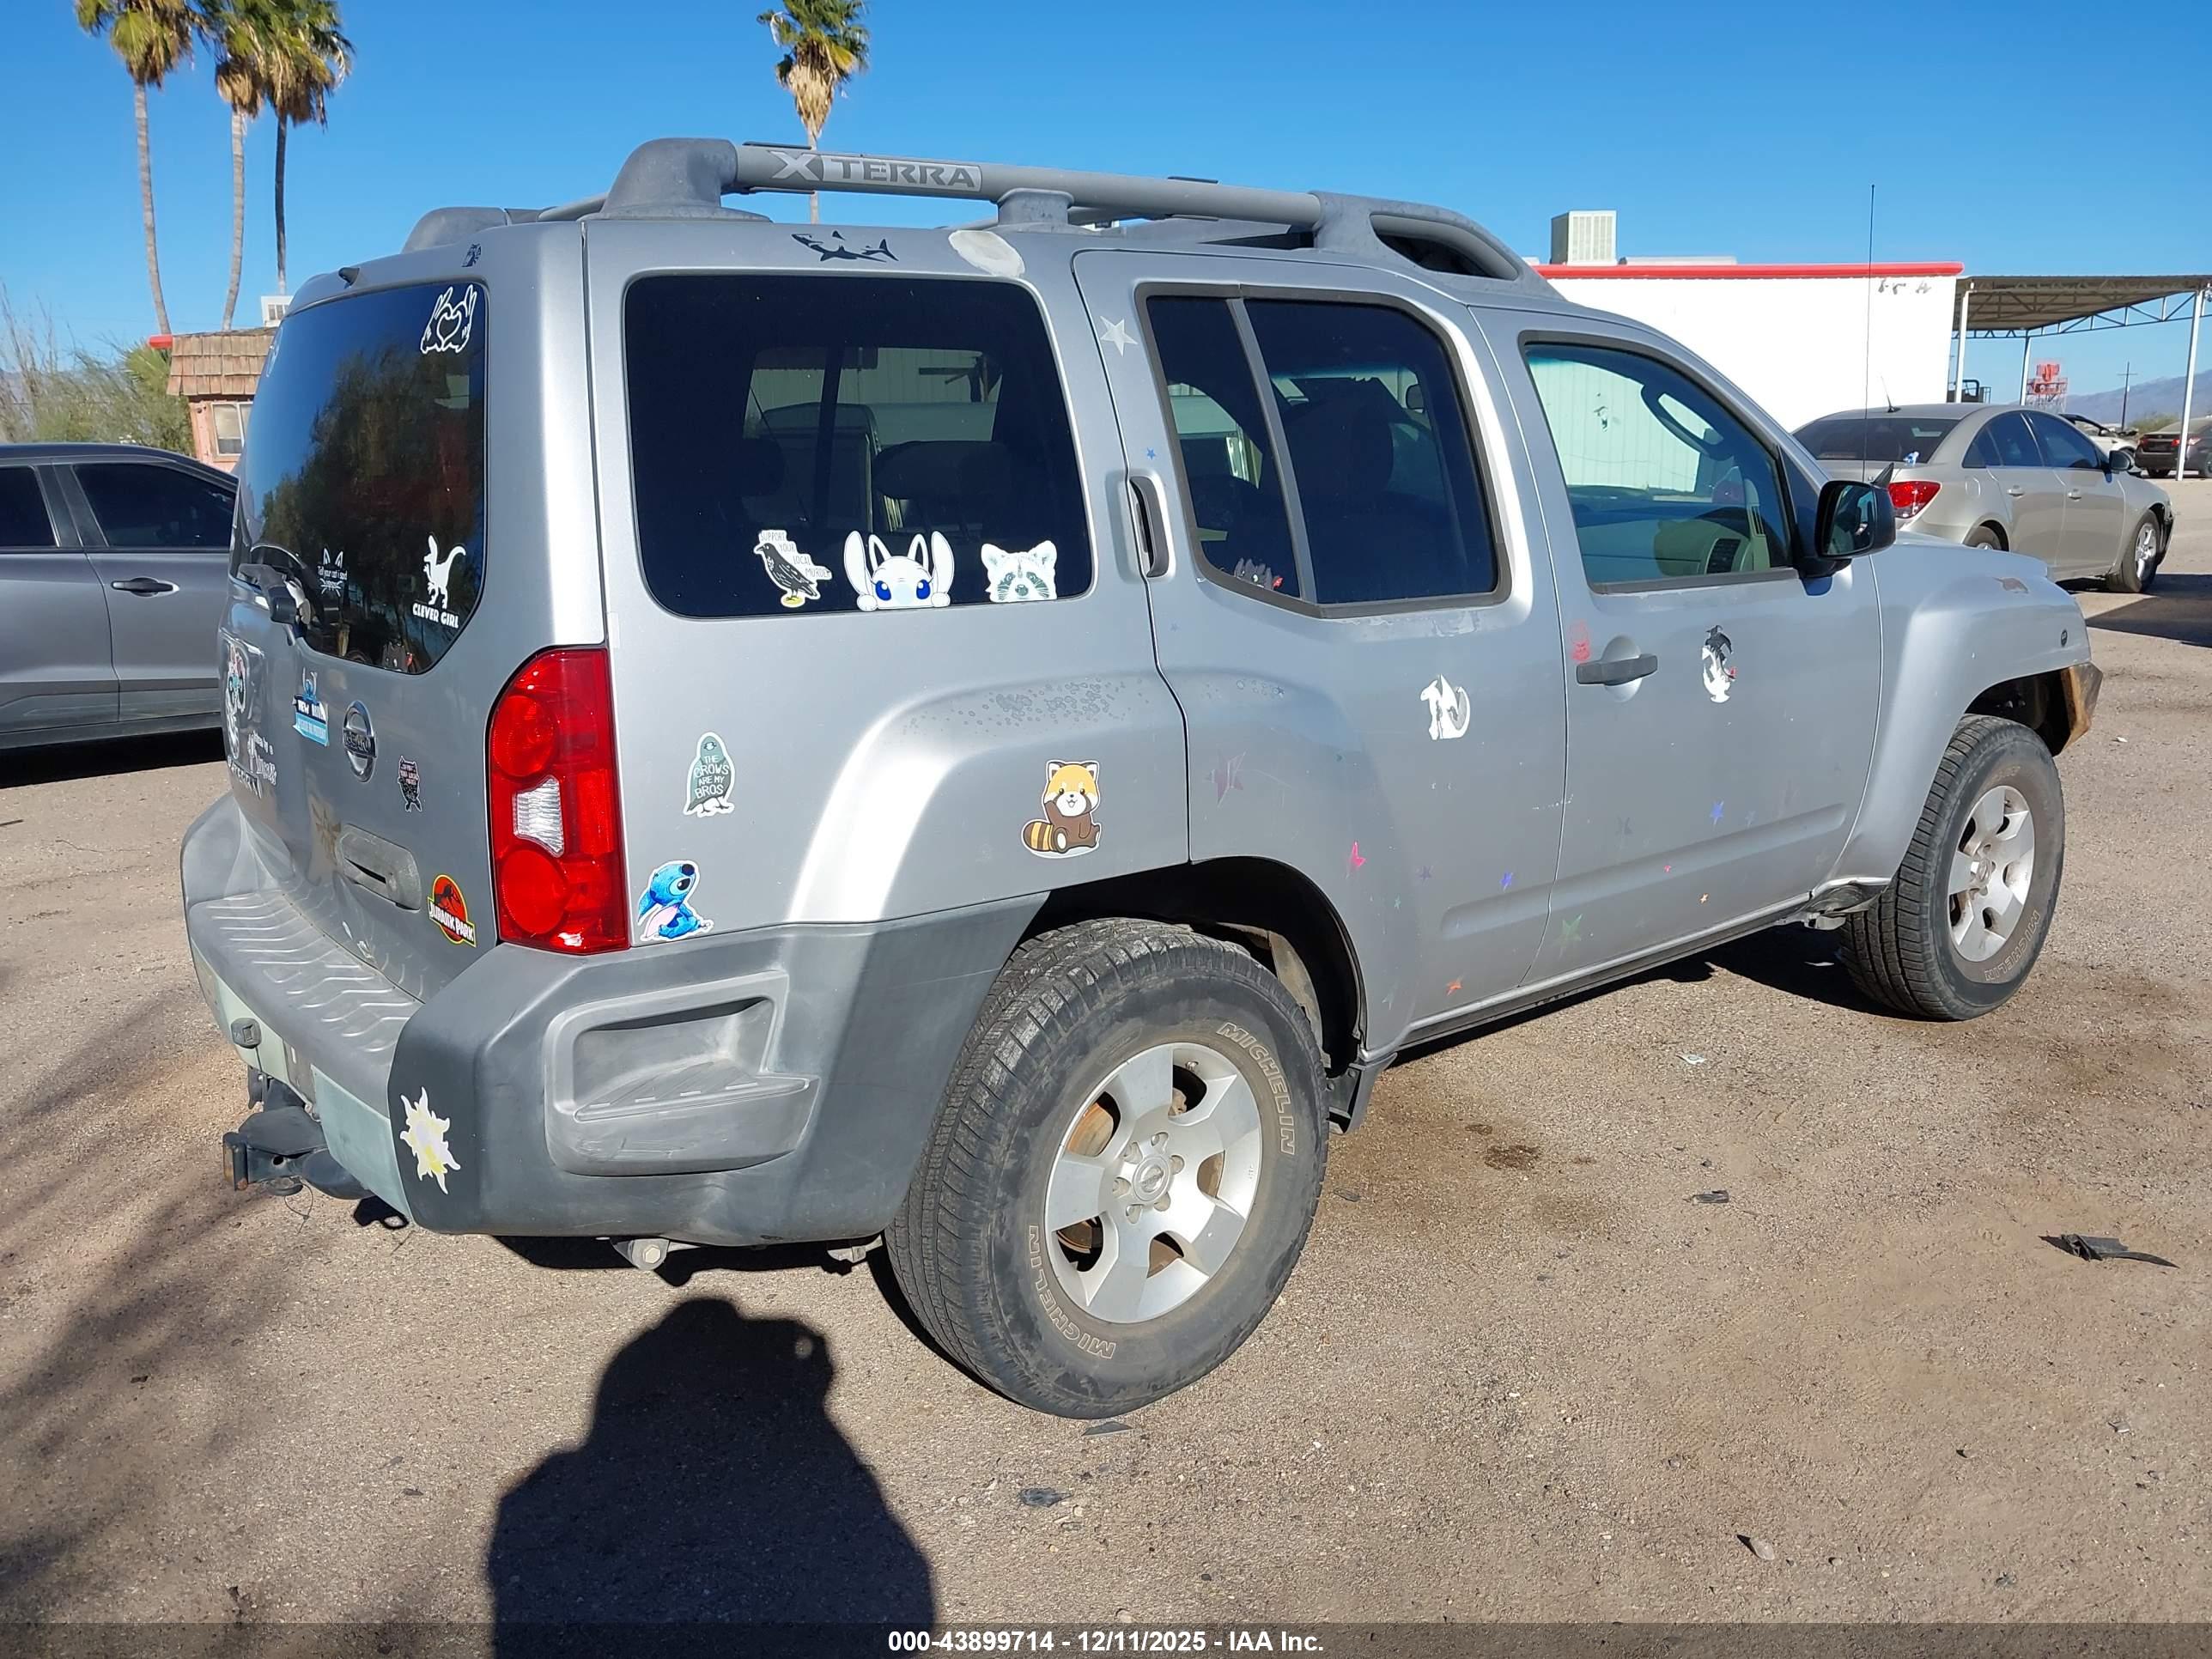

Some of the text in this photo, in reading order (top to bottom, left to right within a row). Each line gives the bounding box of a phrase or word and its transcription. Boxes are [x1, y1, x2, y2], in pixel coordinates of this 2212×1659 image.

[768, 150, 977, 190] XTERRA
[761, 532, 785, 541] SUPPORT
[779, 544, 795, 552] YOUR
[793, 556, 811, 565] LOCAL
[412, 602, 459, 629] CLEVER GIRL
[694, 763, 730, 778] CROWS
[698, 775, 726, 786] ARE MY
[694, 784, 725, 799] BROS
[455, 918, 474, 942] PARK
[1984, 909, 2041, 981] MICHELIN
[1216, 1022, 1296, 1156] MICHELIN
[1029, 1224, 1116, 1359] MICHELIN
